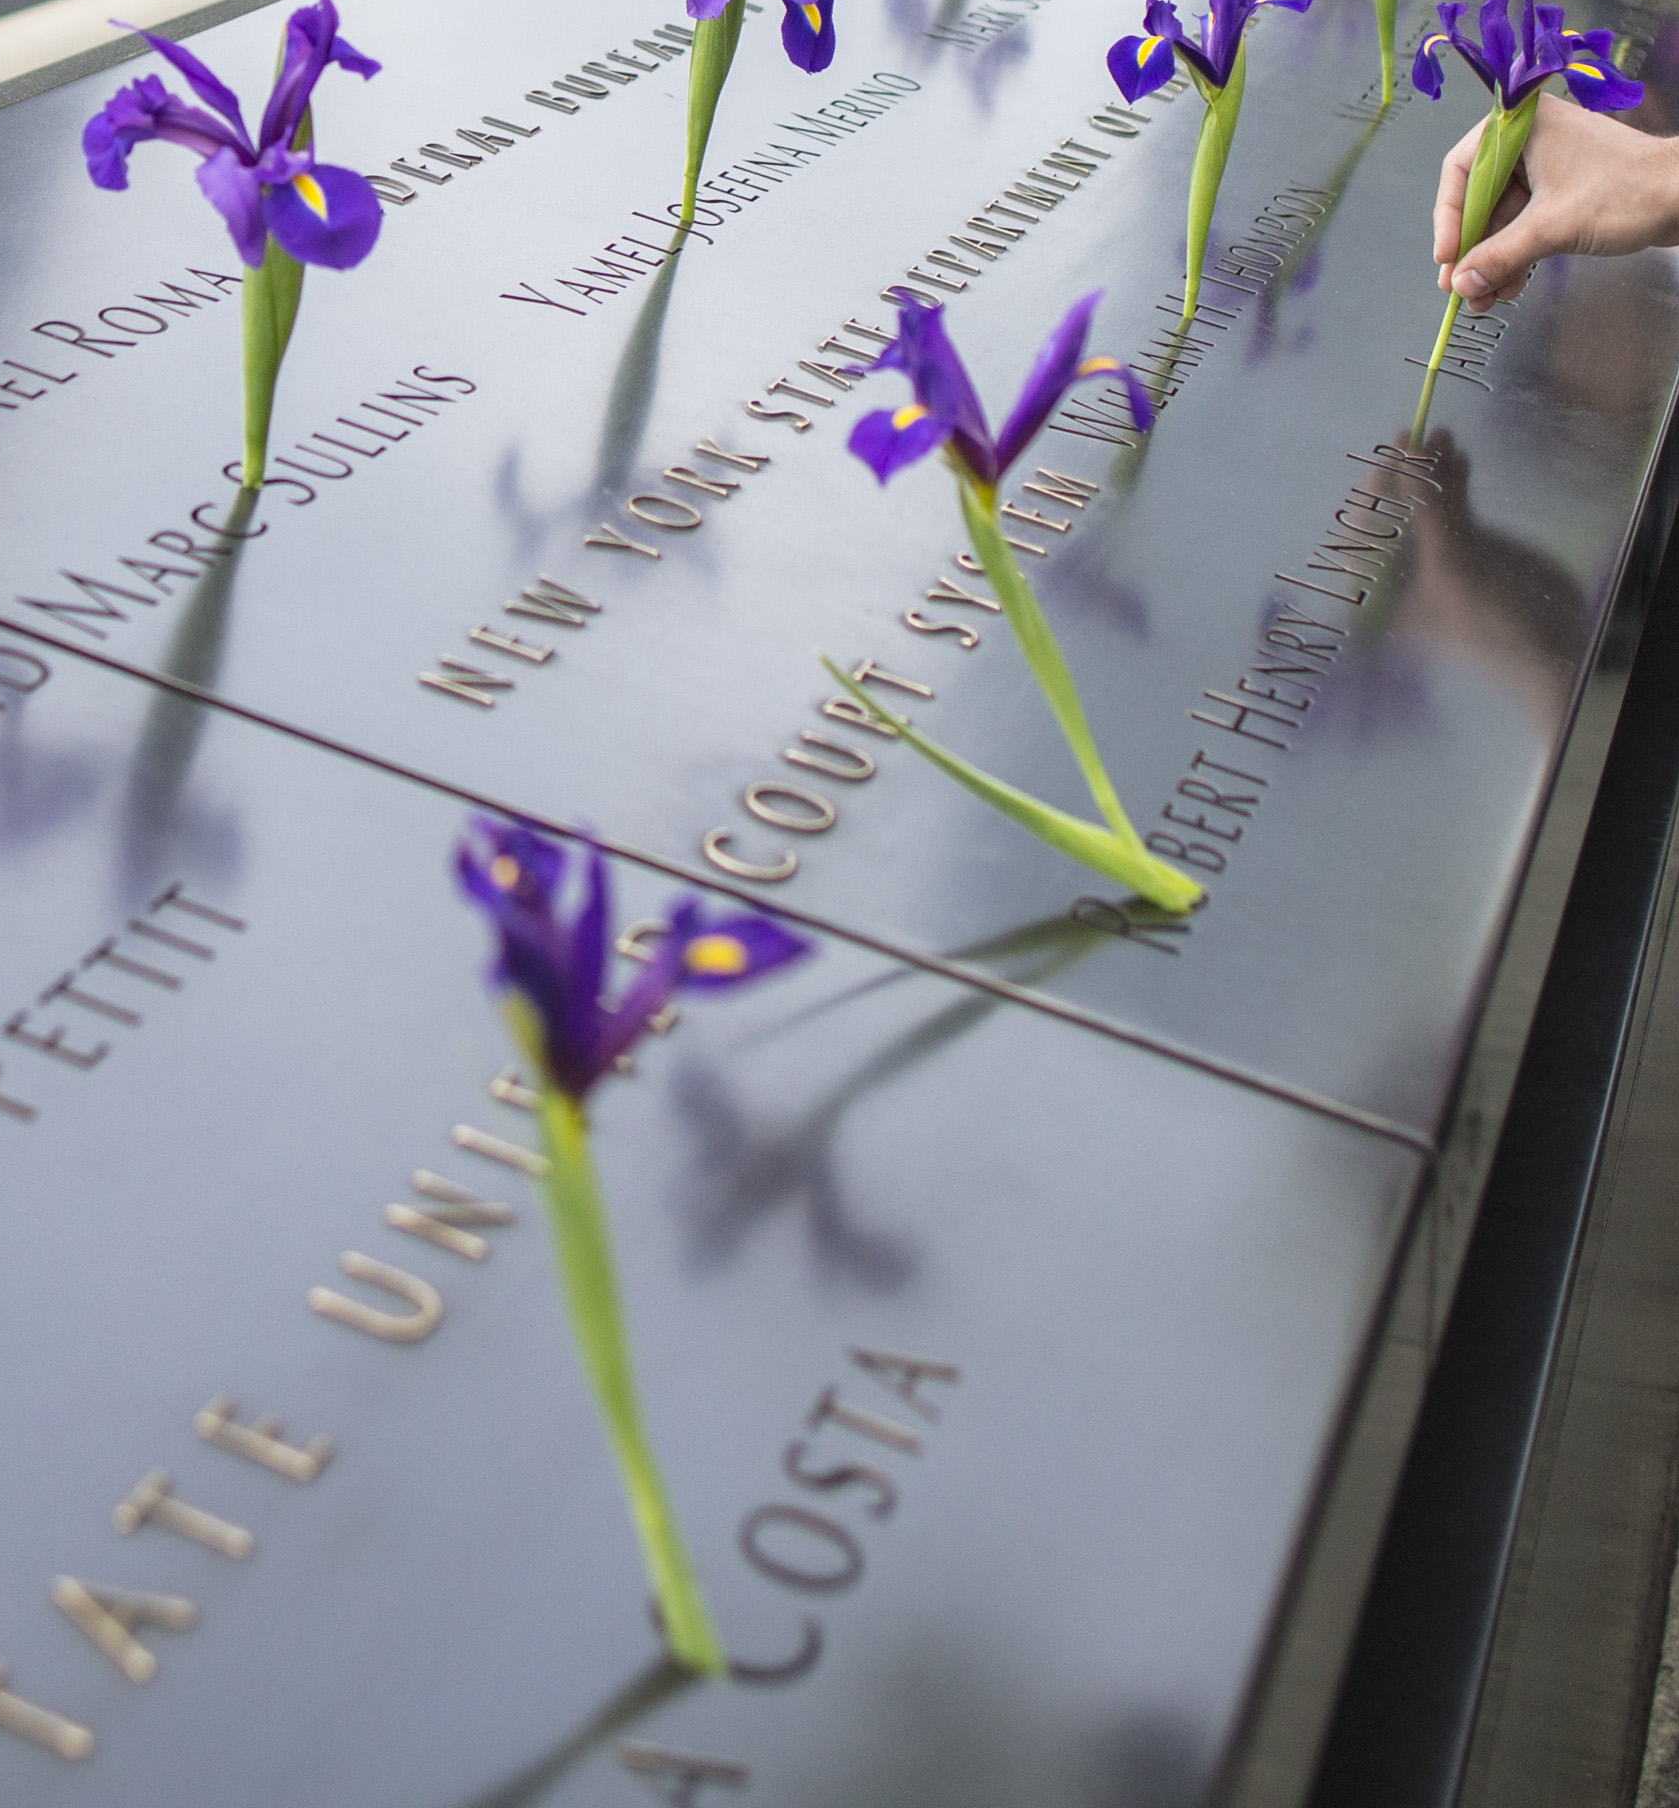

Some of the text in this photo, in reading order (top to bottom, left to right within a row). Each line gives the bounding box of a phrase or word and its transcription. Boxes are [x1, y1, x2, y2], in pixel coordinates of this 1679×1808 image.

[524, 22, 696, 115] BUREAU
[921, 3, 1026, 53] MARK
[499, 71, 922, 316] YAMEL JOSEFINA MERINO
[30, 266, 244, 358] ROMA
[418, 572, 603, 709] NEW
[582, 438, 771, 559] YORK
[742, 317, 900, 433] STATE
[879, 136, 1112, 310] DEPARTMENT
[1088, 100, 1152, 138] OF
[1047, 179, 1338, 448] WILLIAM H. THOMPSON
[1403, 302, 1509, 392] JAMES
[13, 502, 269, 640] MARC
[221, 364, 478, 507] SULLINS
[702, 658, 936, 882] COURT
[1068, 444, 1444, 957] RBERT HENRY LYNCH, JR.
